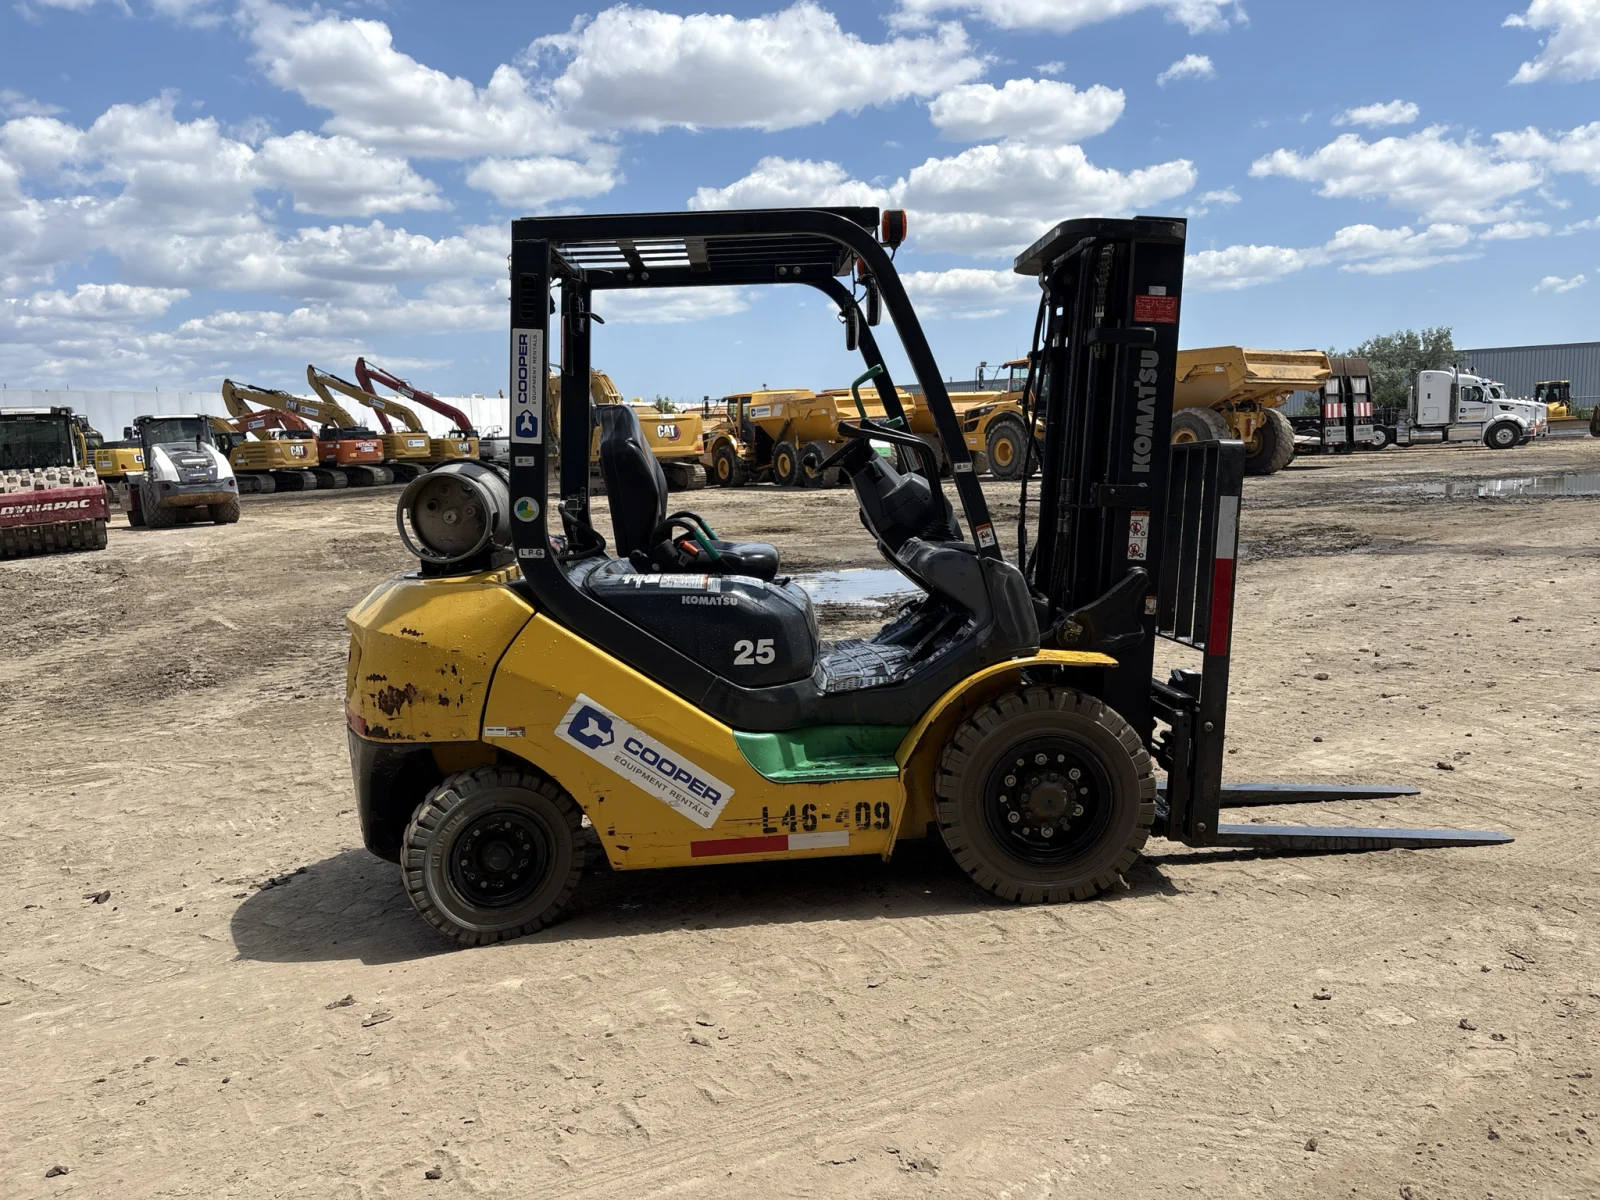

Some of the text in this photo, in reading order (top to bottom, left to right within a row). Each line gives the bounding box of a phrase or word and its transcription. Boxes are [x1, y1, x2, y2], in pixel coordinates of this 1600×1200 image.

[518, 333, 528, 404] COOPER
[285, 400, 298, 411] CAT
[1131, 349, 1160, 473] KOMATSU
[657, 424, 677, 438] CAT
[290, 445, 304, 456] CAT
[458, 443, 470, 451] CAT
[0, 499, 90, 515] DYNAPAC
[682, 594, 738, 606] KOMATSU
[733, 638, 776, 665] 25
[623, 737, 722, 806] COOPER
[613, 754, 710, 818] EQUIPMENT RENTALS
